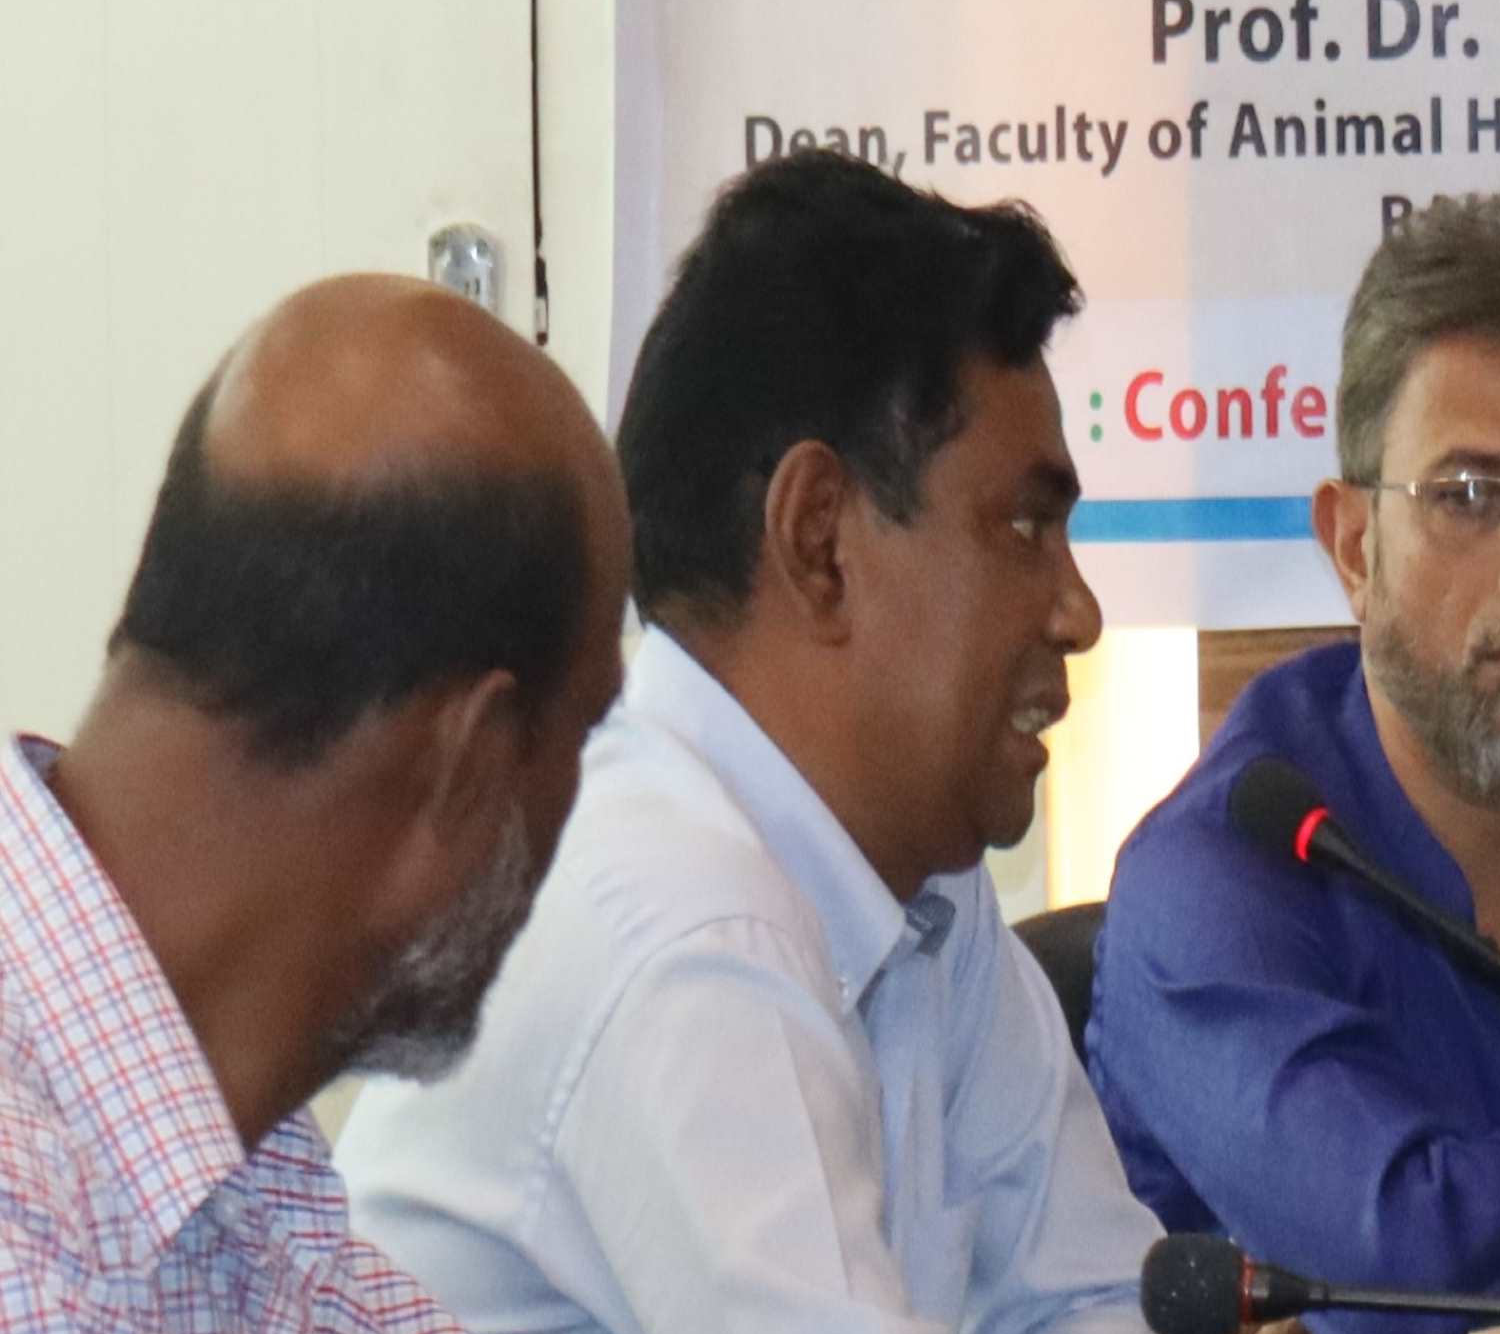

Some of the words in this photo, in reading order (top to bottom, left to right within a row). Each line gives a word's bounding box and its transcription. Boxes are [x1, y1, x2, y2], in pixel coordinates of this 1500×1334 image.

[925, 105, 1128, 177] Faculty
[1149, 100, 1208, 159] of
[1229, 97, 1442, 157] Animal
[1124, 365, 1327, 441] Confe
